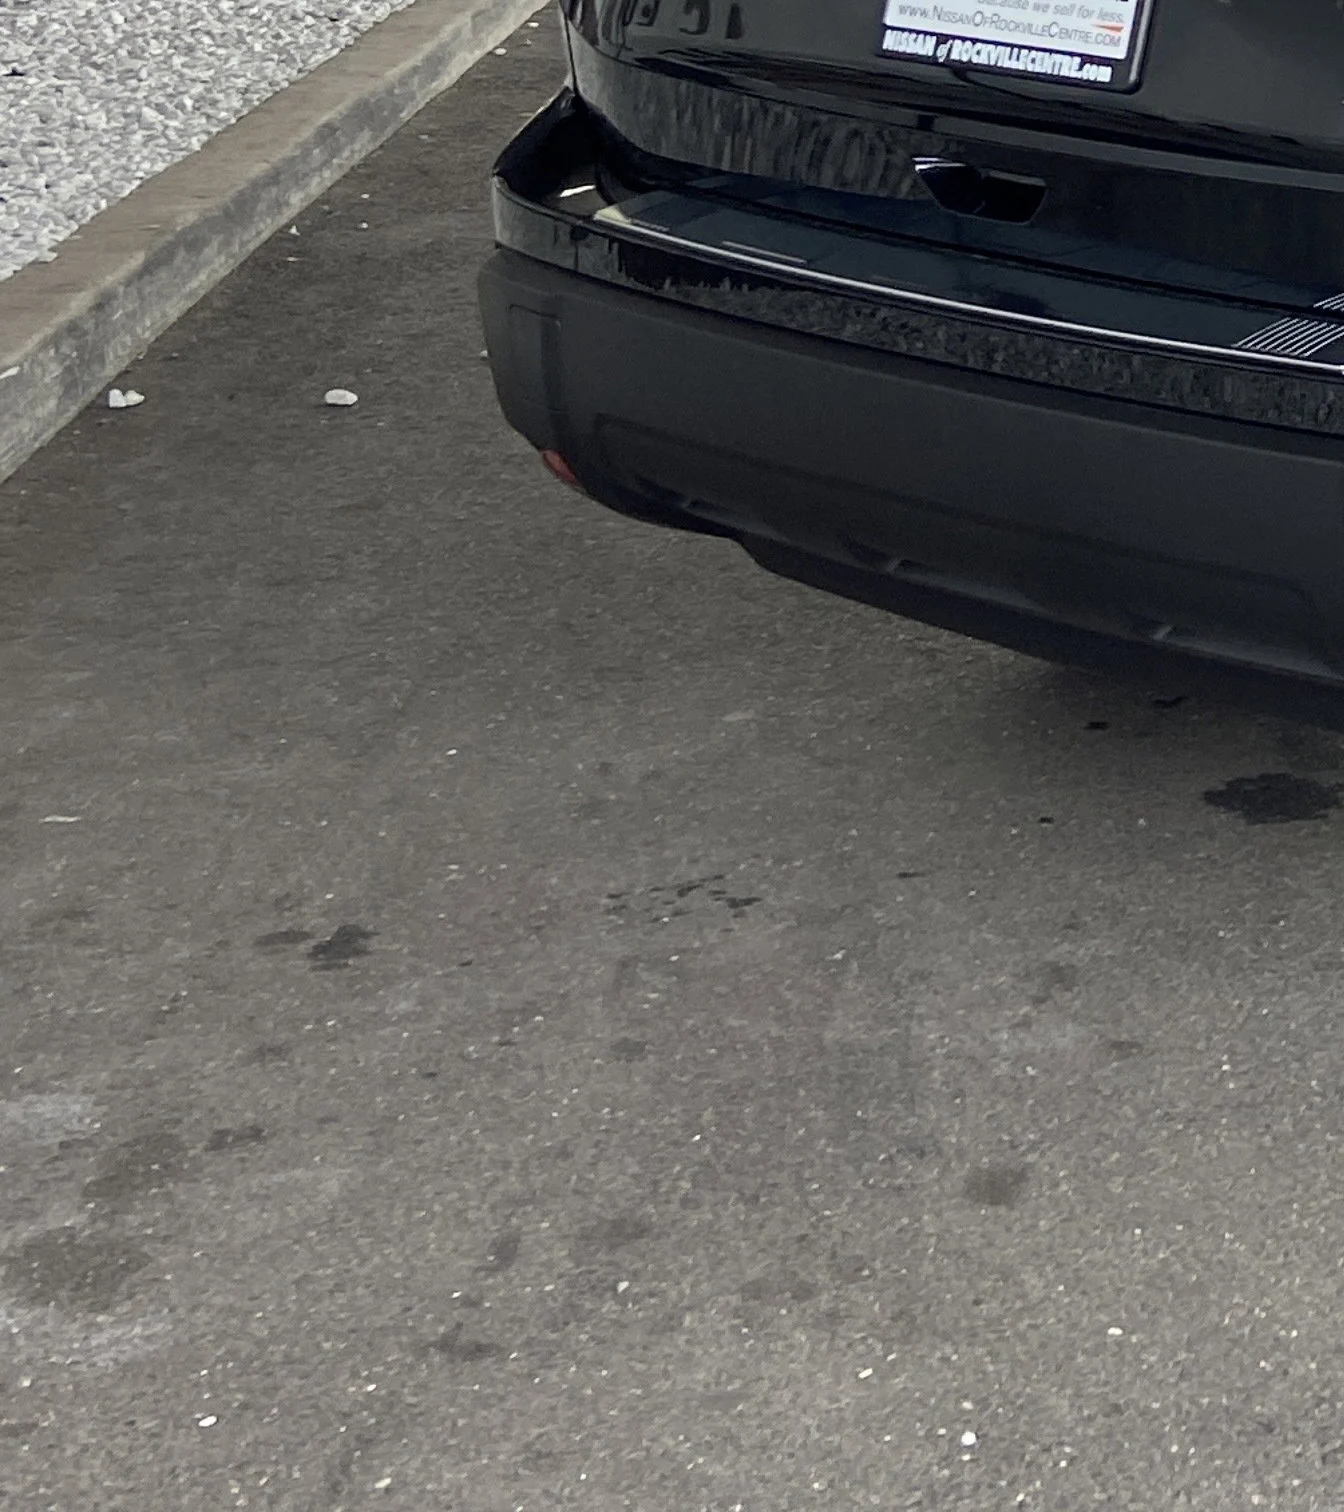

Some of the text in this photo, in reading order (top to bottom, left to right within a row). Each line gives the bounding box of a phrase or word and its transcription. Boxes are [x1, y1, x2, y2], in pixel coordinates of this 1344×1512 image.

[1032, 0, 1051, 13] we
[1053, 1, 1075, 17] sell
[1077, 4, 1095, 20] for
[882, 29, 937, 56] NISSAN
[937, 40, 952, 63] of
